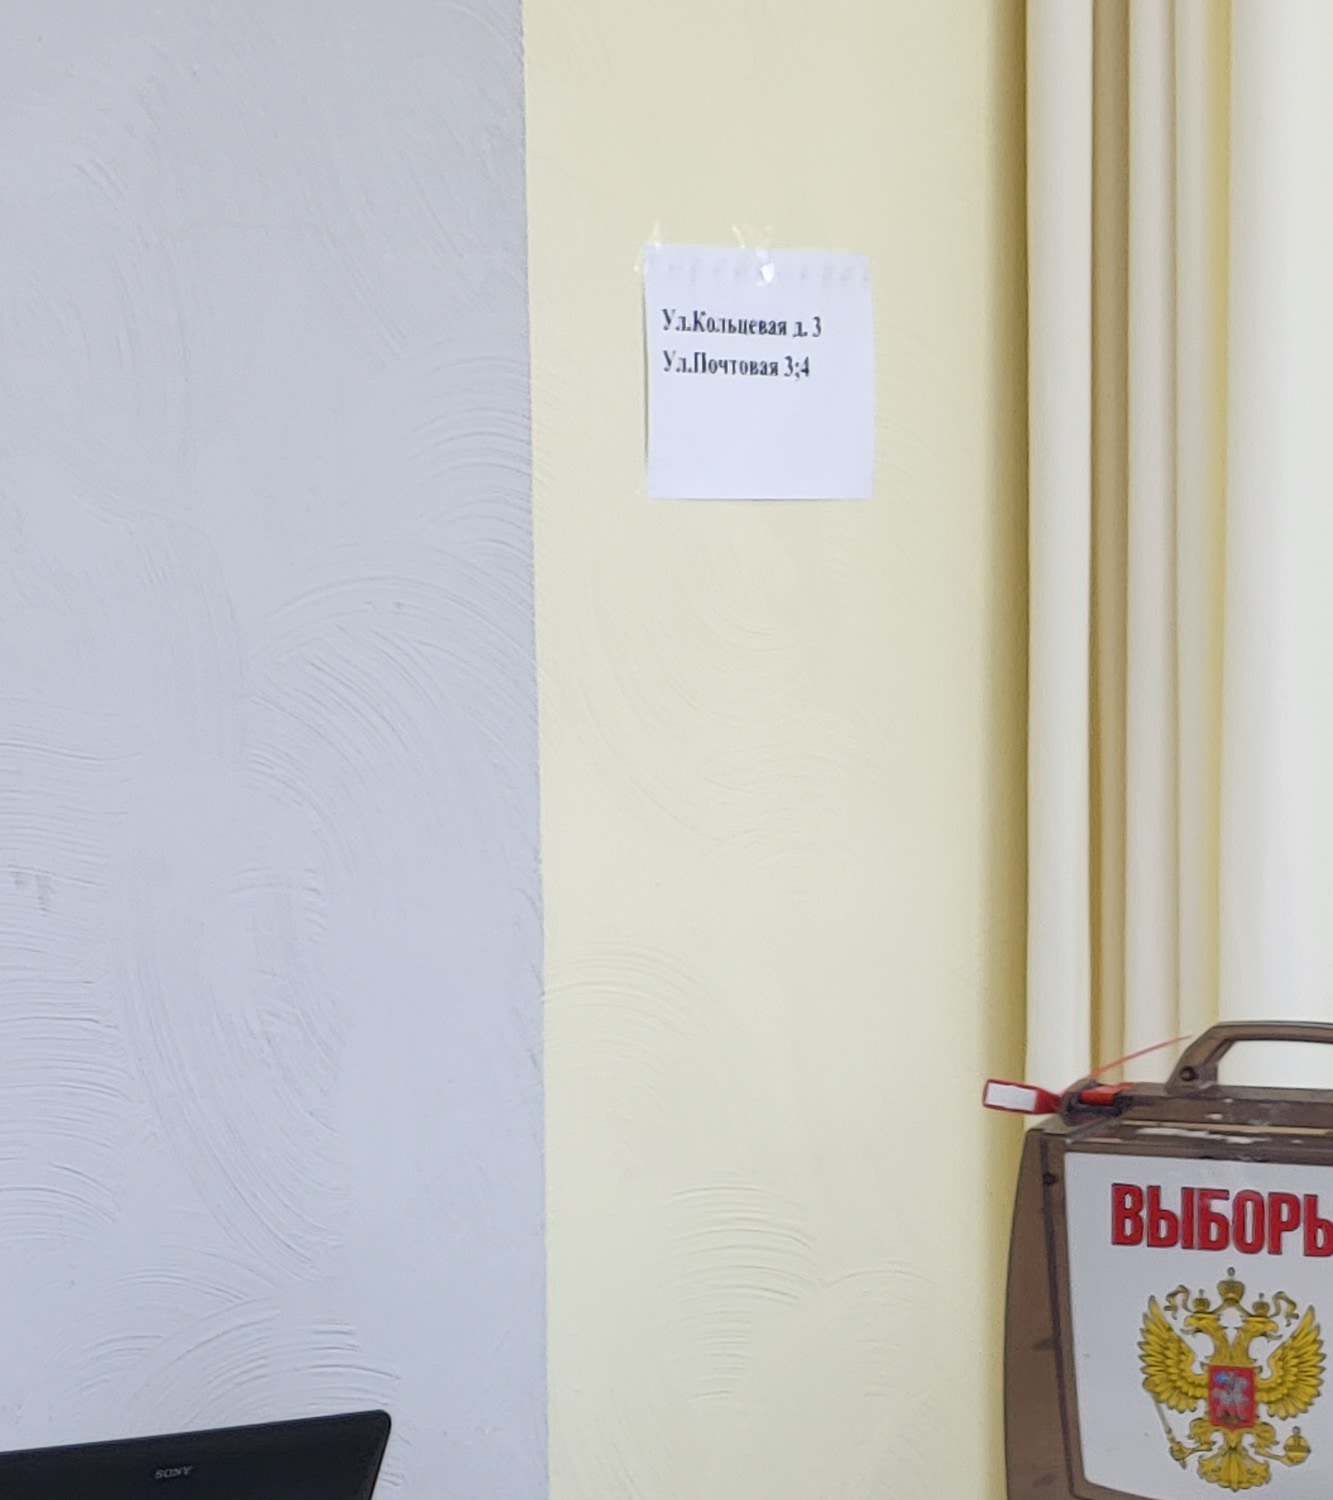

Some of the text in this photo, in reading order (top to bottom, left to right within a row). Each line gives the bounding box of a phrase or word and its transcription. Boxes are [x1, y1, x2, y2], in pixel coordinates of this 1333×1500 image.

[661, 308, 787, 337] Ул.Кольцевая
[812, 315, 822, 338] 3
[662, 349, 811, 382] Ул.Почтовая 3;4
